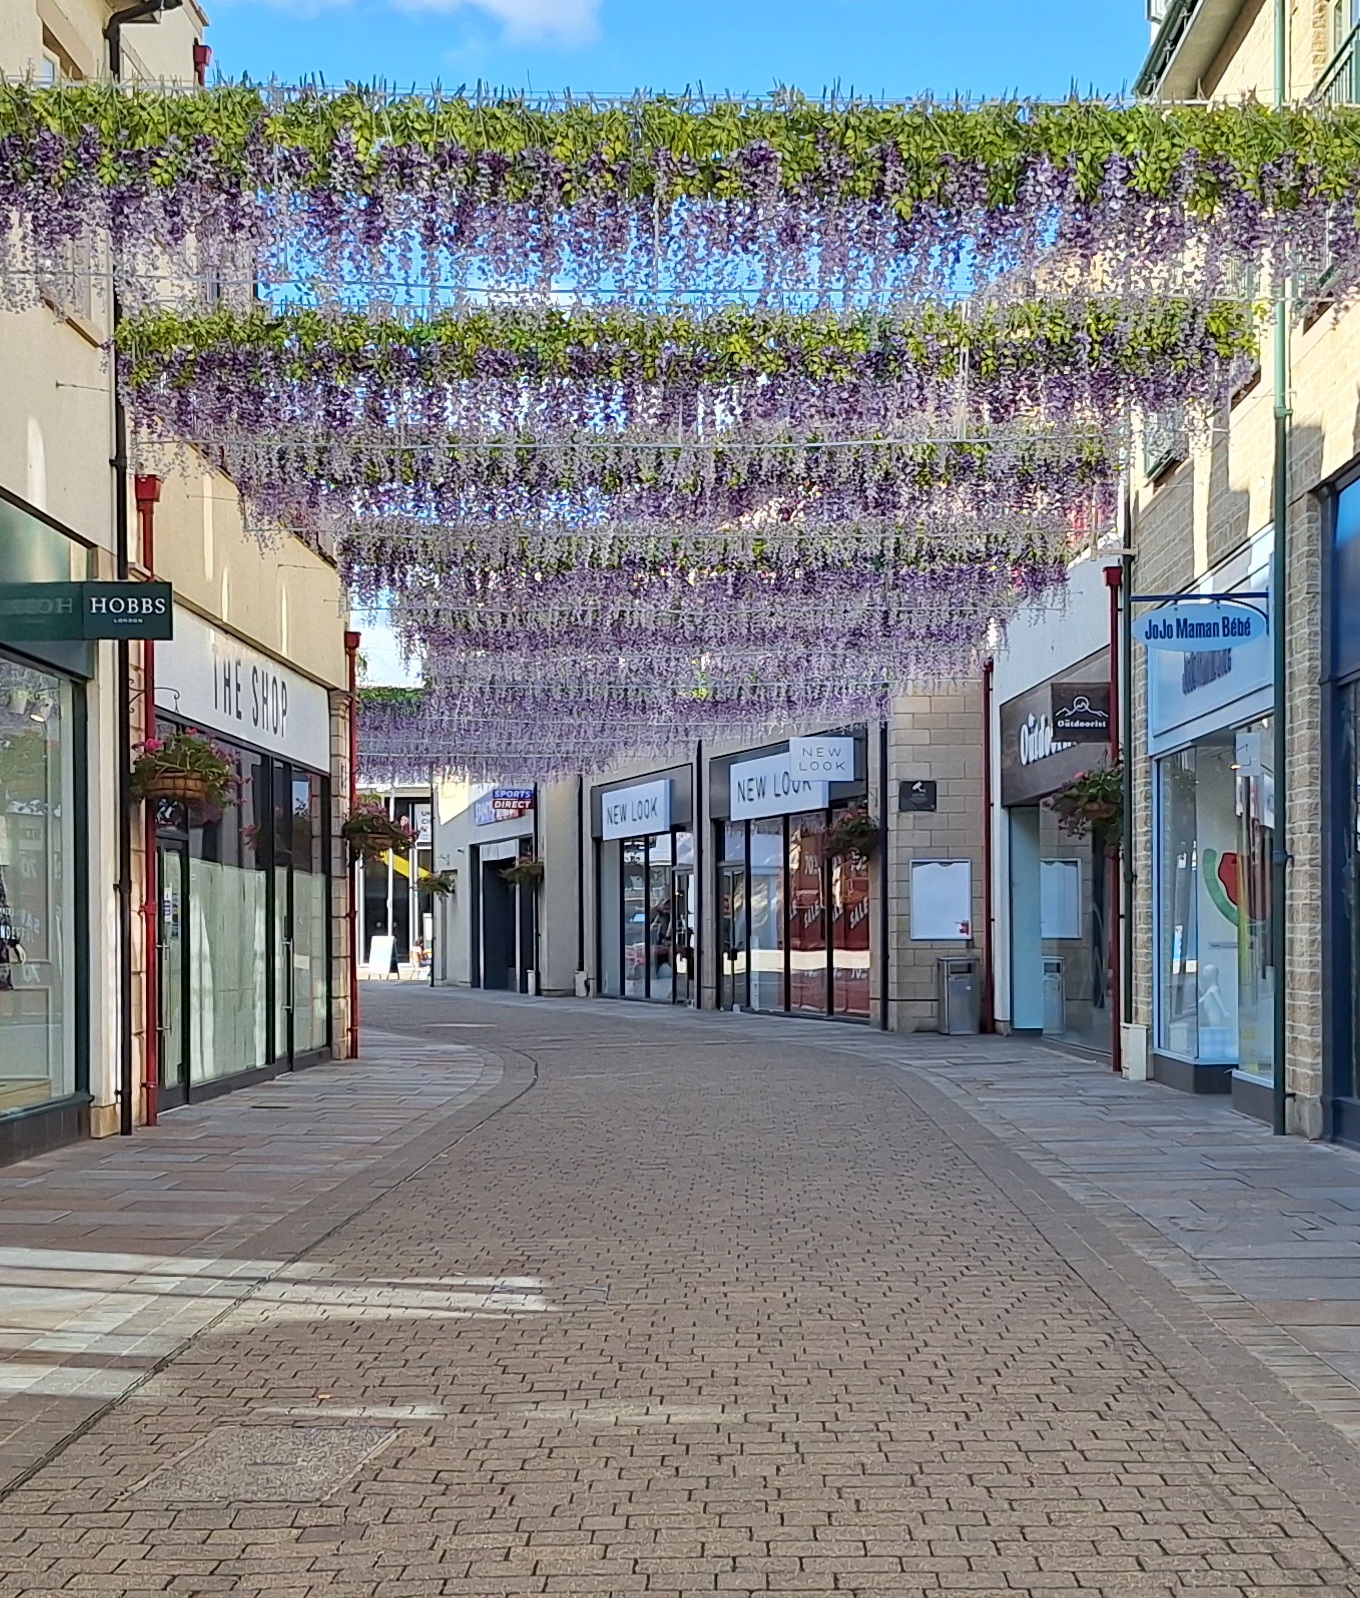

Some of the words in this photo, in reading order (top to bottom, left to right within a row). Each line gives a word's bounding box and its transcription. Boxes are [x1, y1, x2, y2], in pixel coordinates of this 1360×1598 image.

[90, 597, 167, 614] HOBBS
[1145, 619, 1174, 640] JoJo
[1176, 617, 1220, 639] Maman
[1222, 616, 1251, 637] Bébé
[212, 644, 242, 720] THE
[252, 665, 287, 738] SHOP
[1057, 720, 1107, 728] Outdoorist
[802, 747, 841, 758] NEW
[799, 761, 846, 772] LOOK
[494, 790, 531, 798] SPORTS
[737, 775, 767, 803] NEW
[494, 801, 531, 809] DIRECT
[606, 804, 627, 826] NEW
[631, 797, 658, 822] LOOK
[803, 900, 820, 930] SALE
[849, 896, 869, 930] SALE
